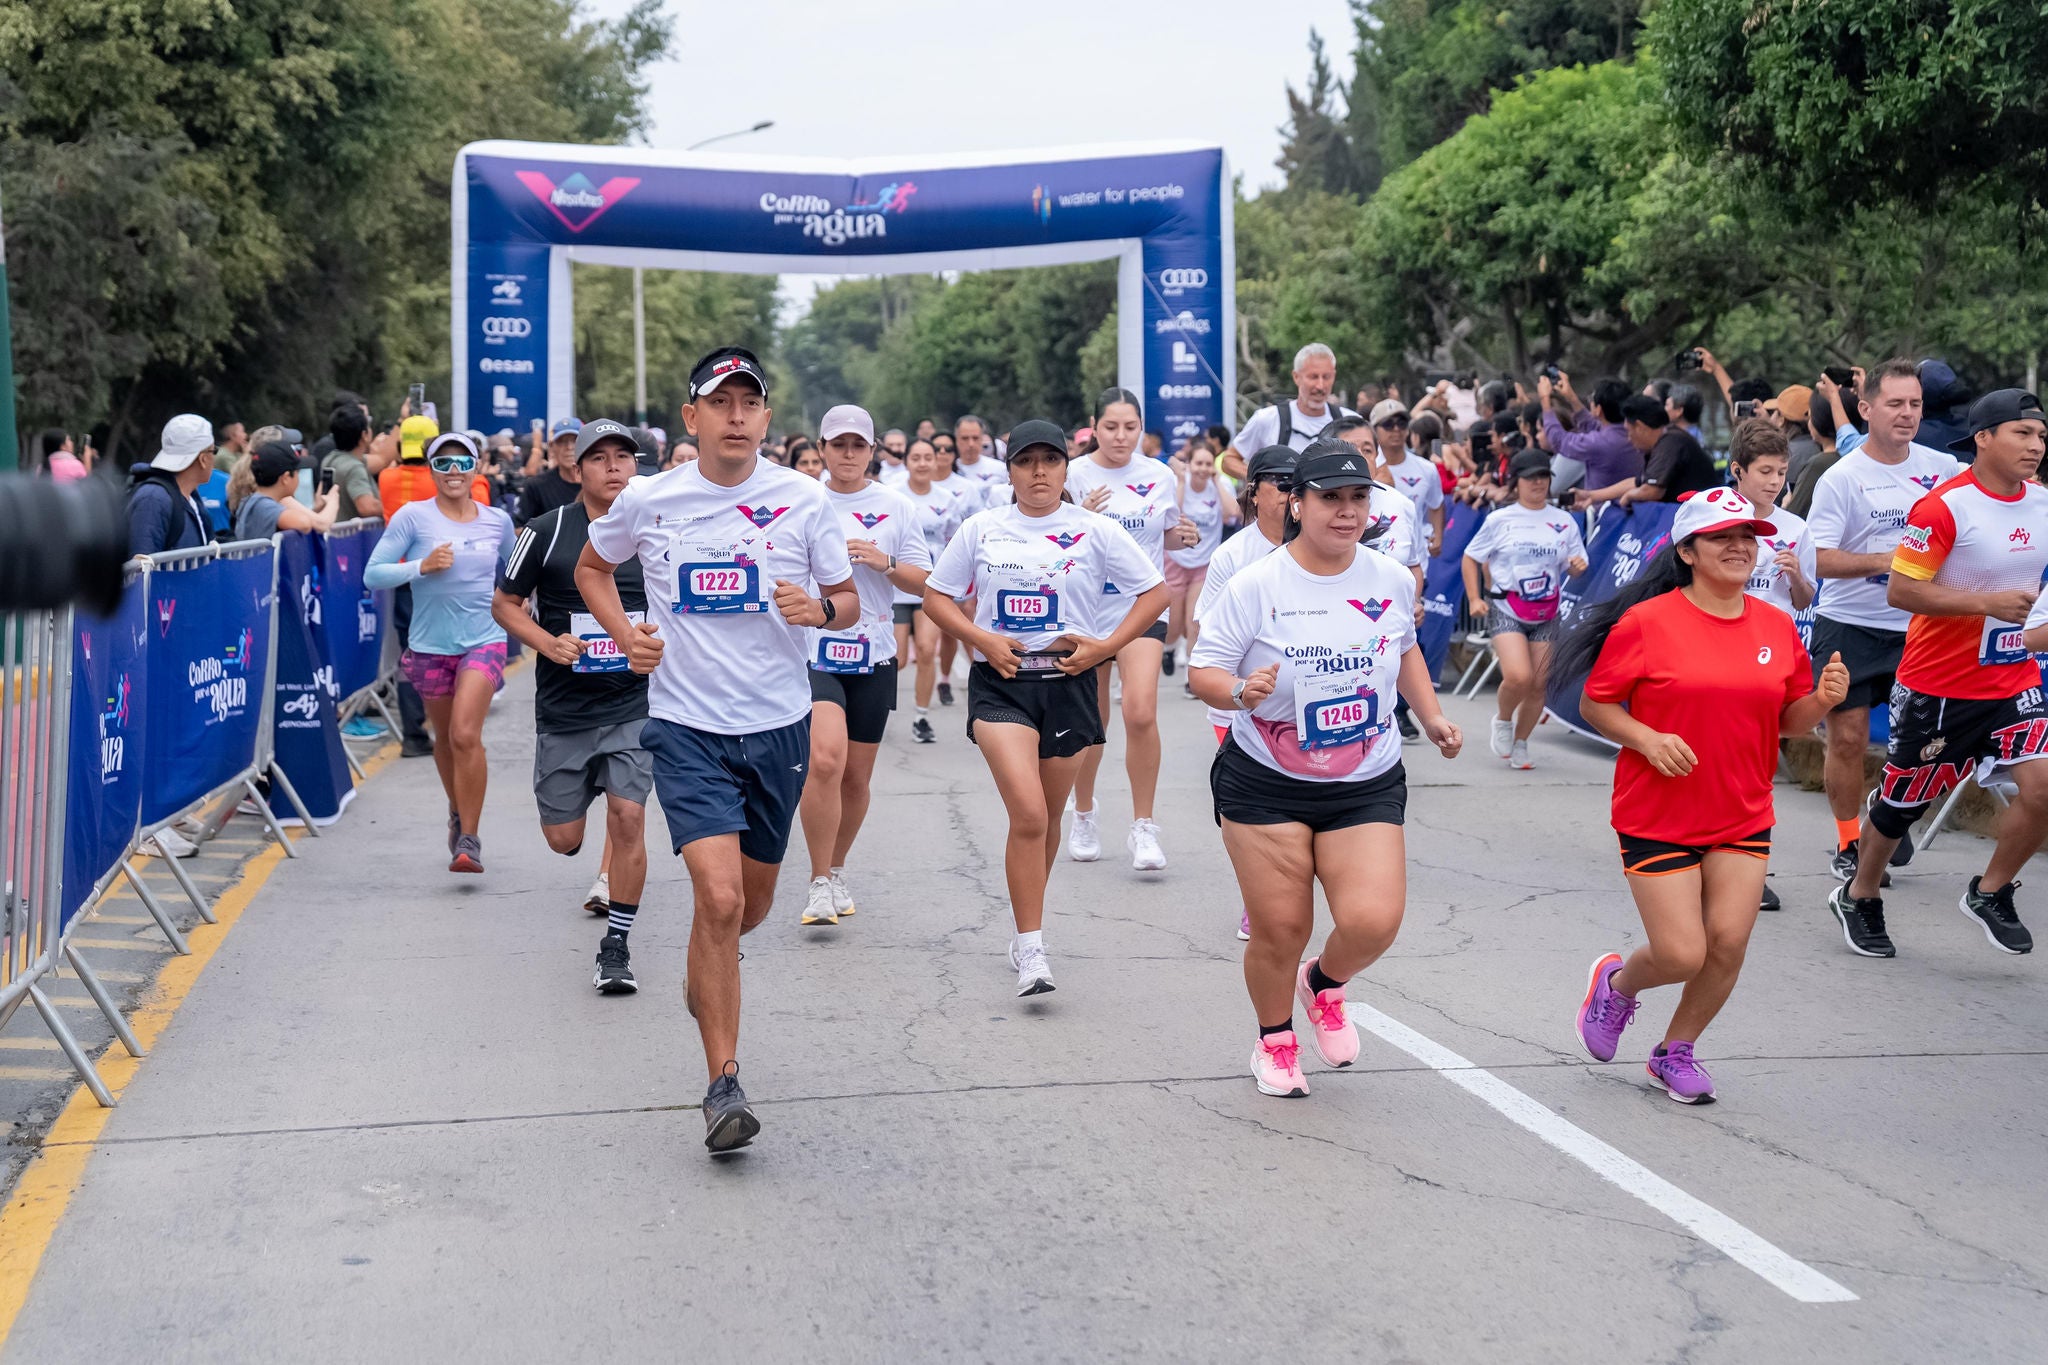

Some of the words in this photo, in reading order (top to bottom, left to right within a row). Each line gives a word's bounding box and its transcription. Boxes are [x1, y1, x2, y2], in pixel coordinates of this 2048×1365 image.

[1058, 191, 1101, 208] water
[1104, 187, 1126, 204] for
[1129, 183, 1184, 205] people
[696, 571, 740, 591] 1222
[1009, 598, 1042, 613] 1125
[592, 640, 625, 656] 129
[2001, 633, 2025, 649] 146
[832, 645, 860, 659] 1371
[1284, 646, 1332, 658] CoRRo
[1295, 658, 1309, 666] por
[1316, 653, 1373, 675] agua
[1321, 703, 1363, 727] 1246
